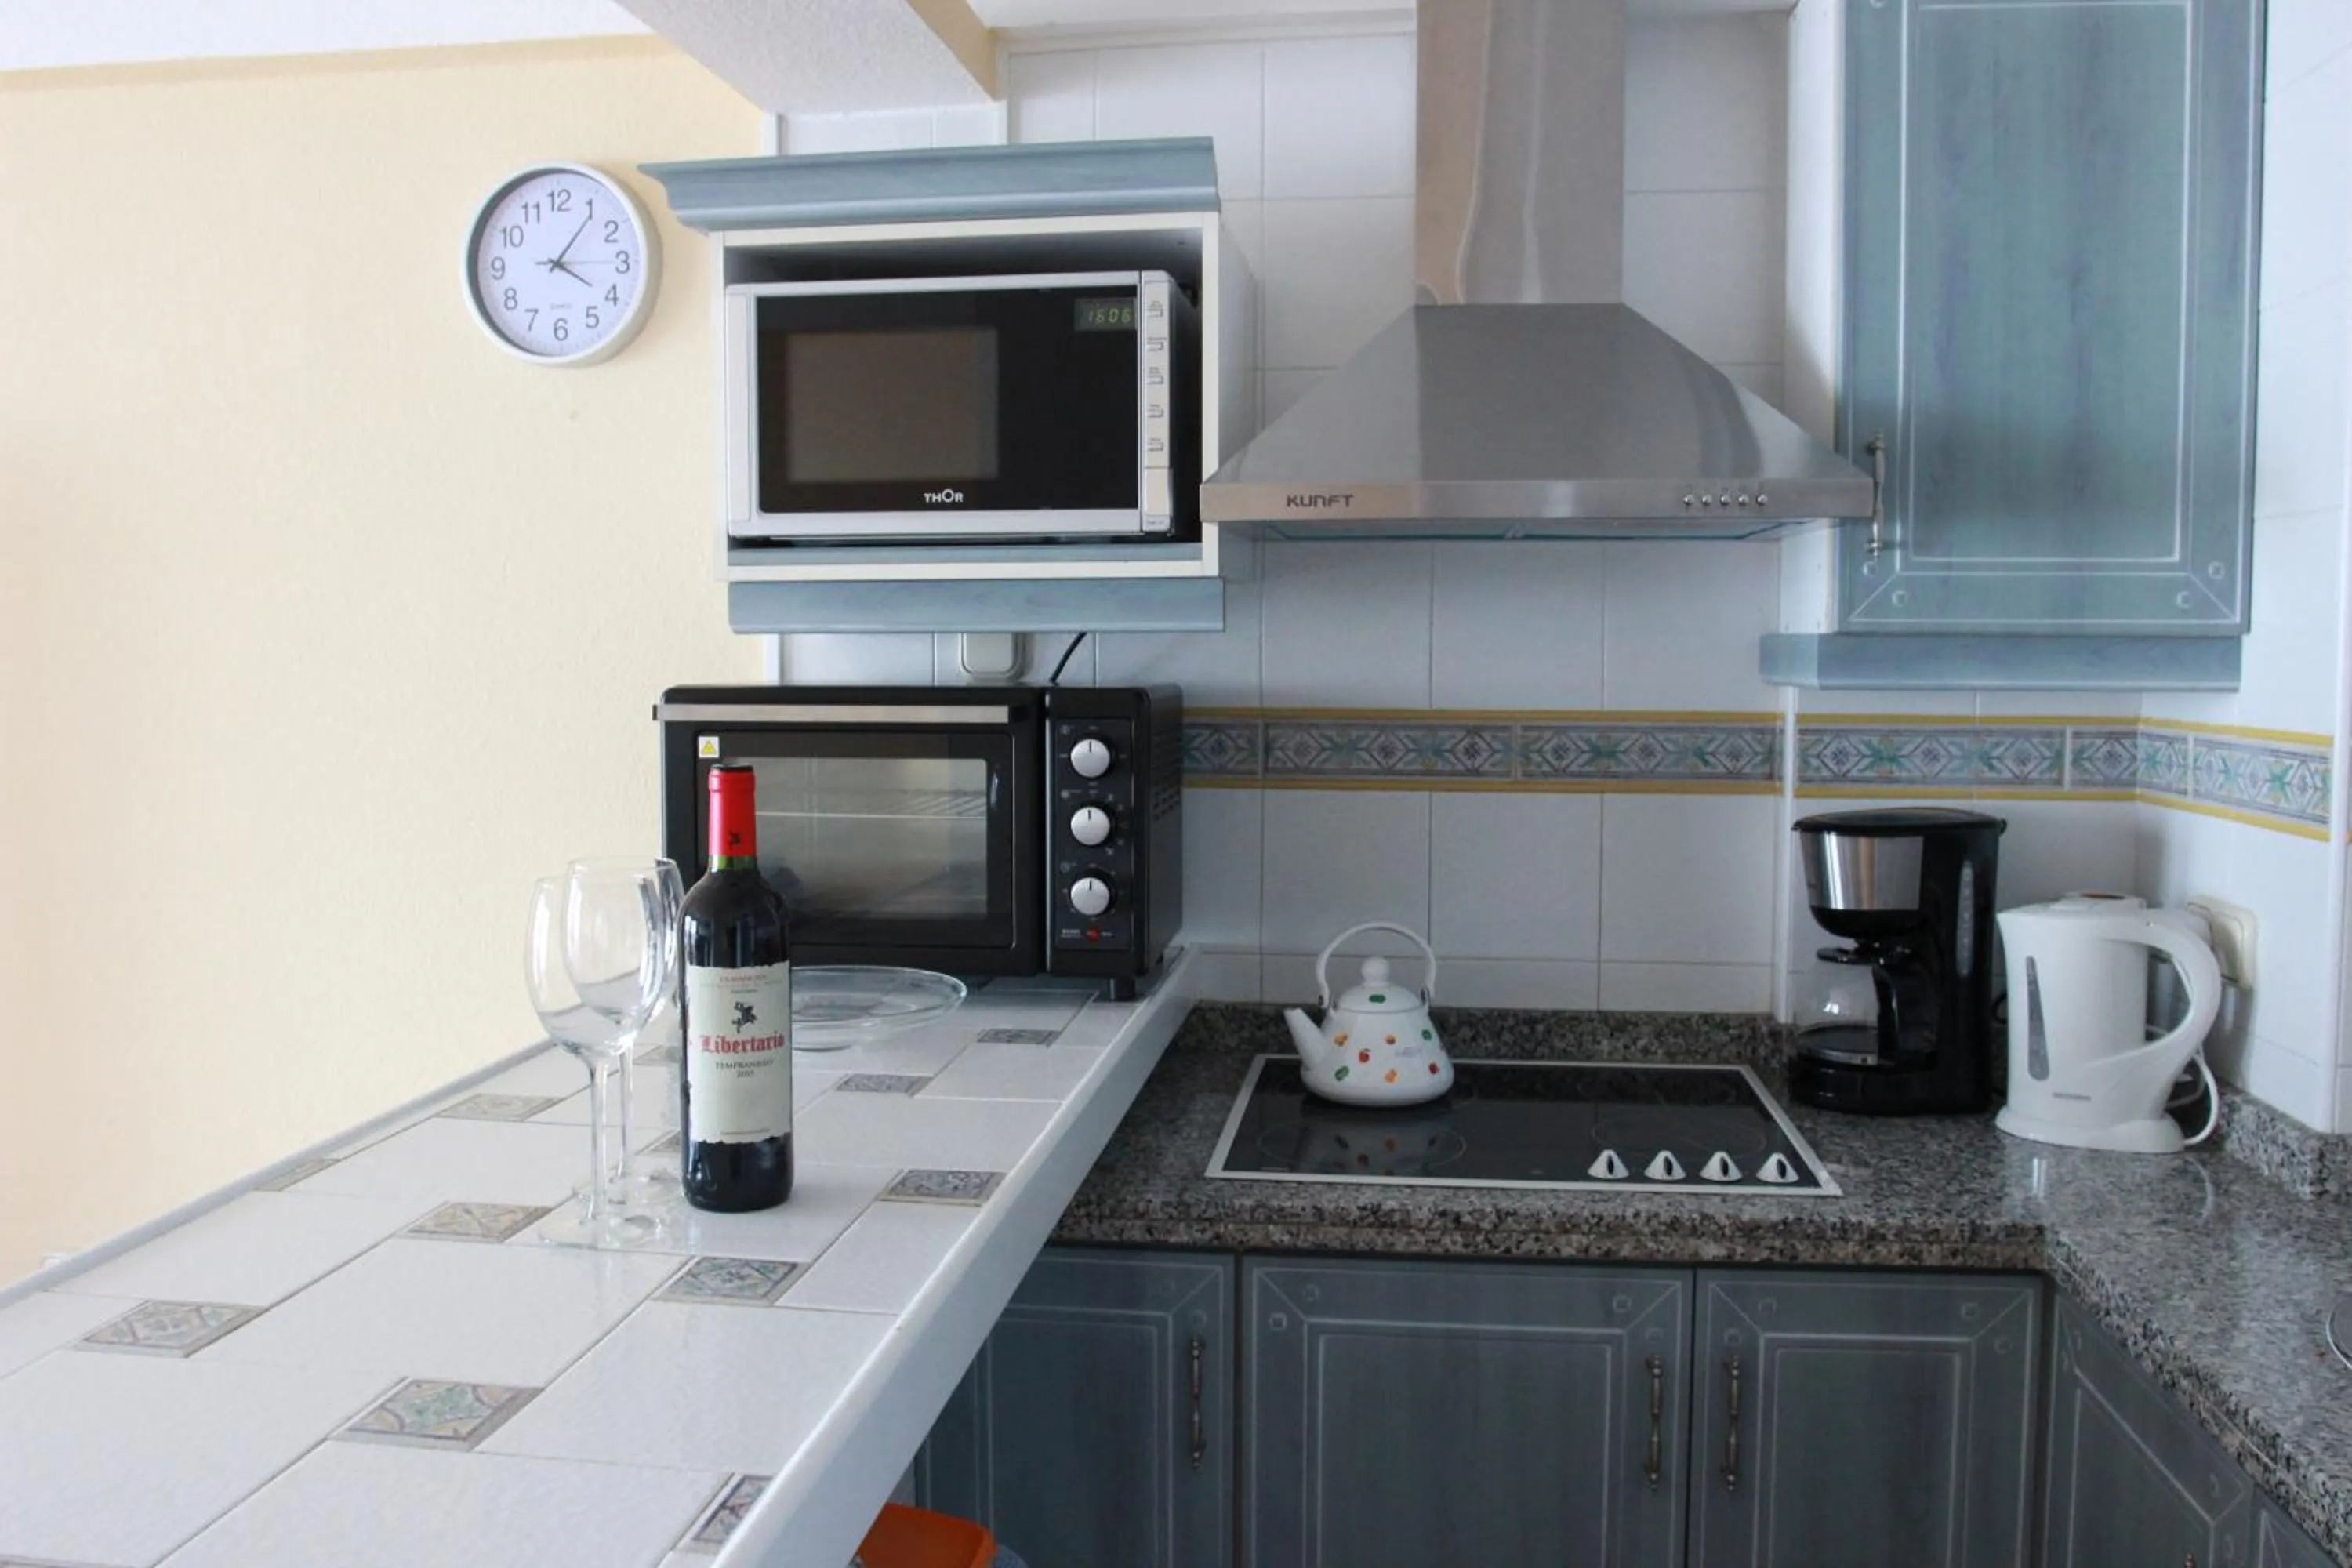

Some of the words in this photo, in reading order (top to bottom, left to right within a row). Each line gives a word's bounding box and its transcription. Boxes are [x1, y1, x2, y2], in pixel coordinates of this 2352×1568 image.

[521, 201, 541, 223] 11
[547, 189, 572, 213] 12
[585, 198, 593, 221] 1
[500, 225, 524, 249] 10
[604, 220, 619, 243] 2
[491, 256, 506, 280] 9
[615, 250, 630, 274] 3
[503, 287, 518, 310] 8
[604, 283, 619, 307] 4
[524, 308, 539, 332] 7
[586, 306, 600, 328] 5
[554, 318, 568, 341] 6
[923, 488, 964, 503] THOR
[1287, 494, 1355, 508] KUNFT
[700, 1030, 785, 1054] Libertario
